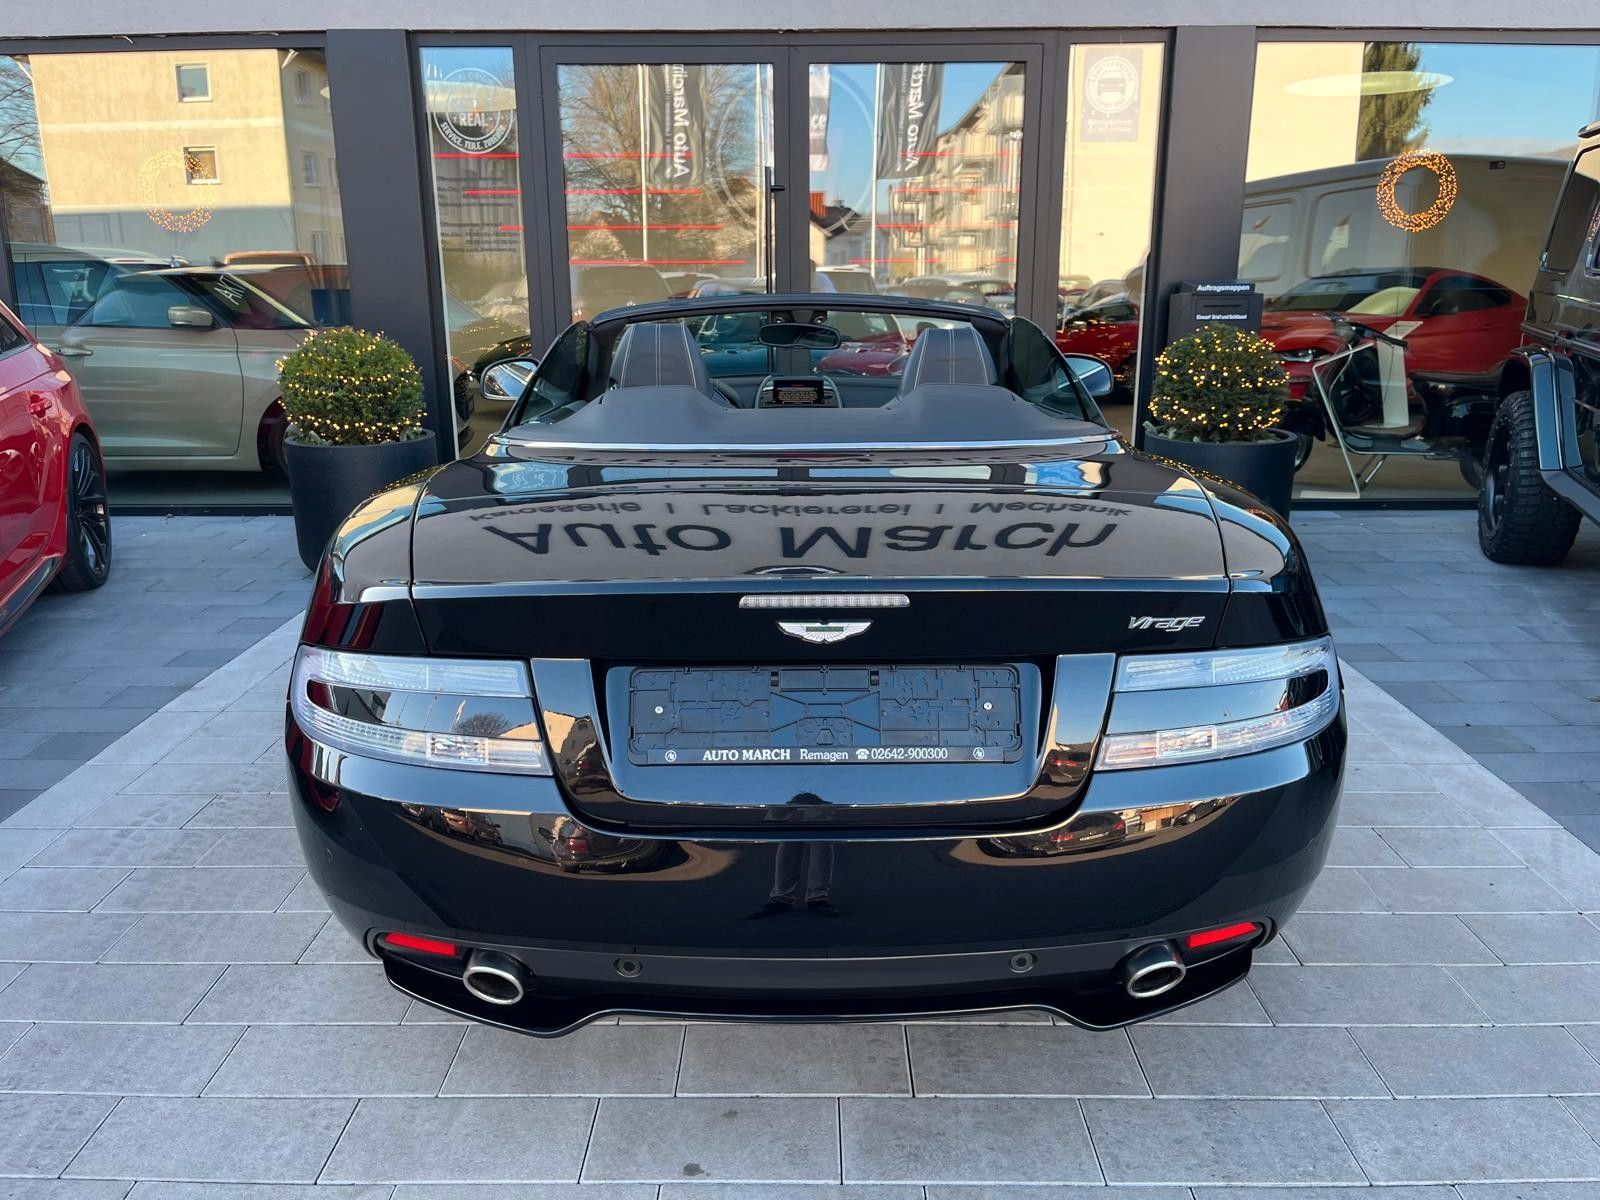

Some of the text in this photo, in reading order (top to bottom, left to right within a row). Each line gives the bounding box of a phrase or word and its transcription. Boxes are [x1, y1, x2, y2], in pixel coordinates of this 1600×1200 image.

[459, 112, 488, 127] REAL
[1128, 616, 1206, 632] Virage
[703, 747, 948, 762] AUTO MARCH Remagen 02642-900300
